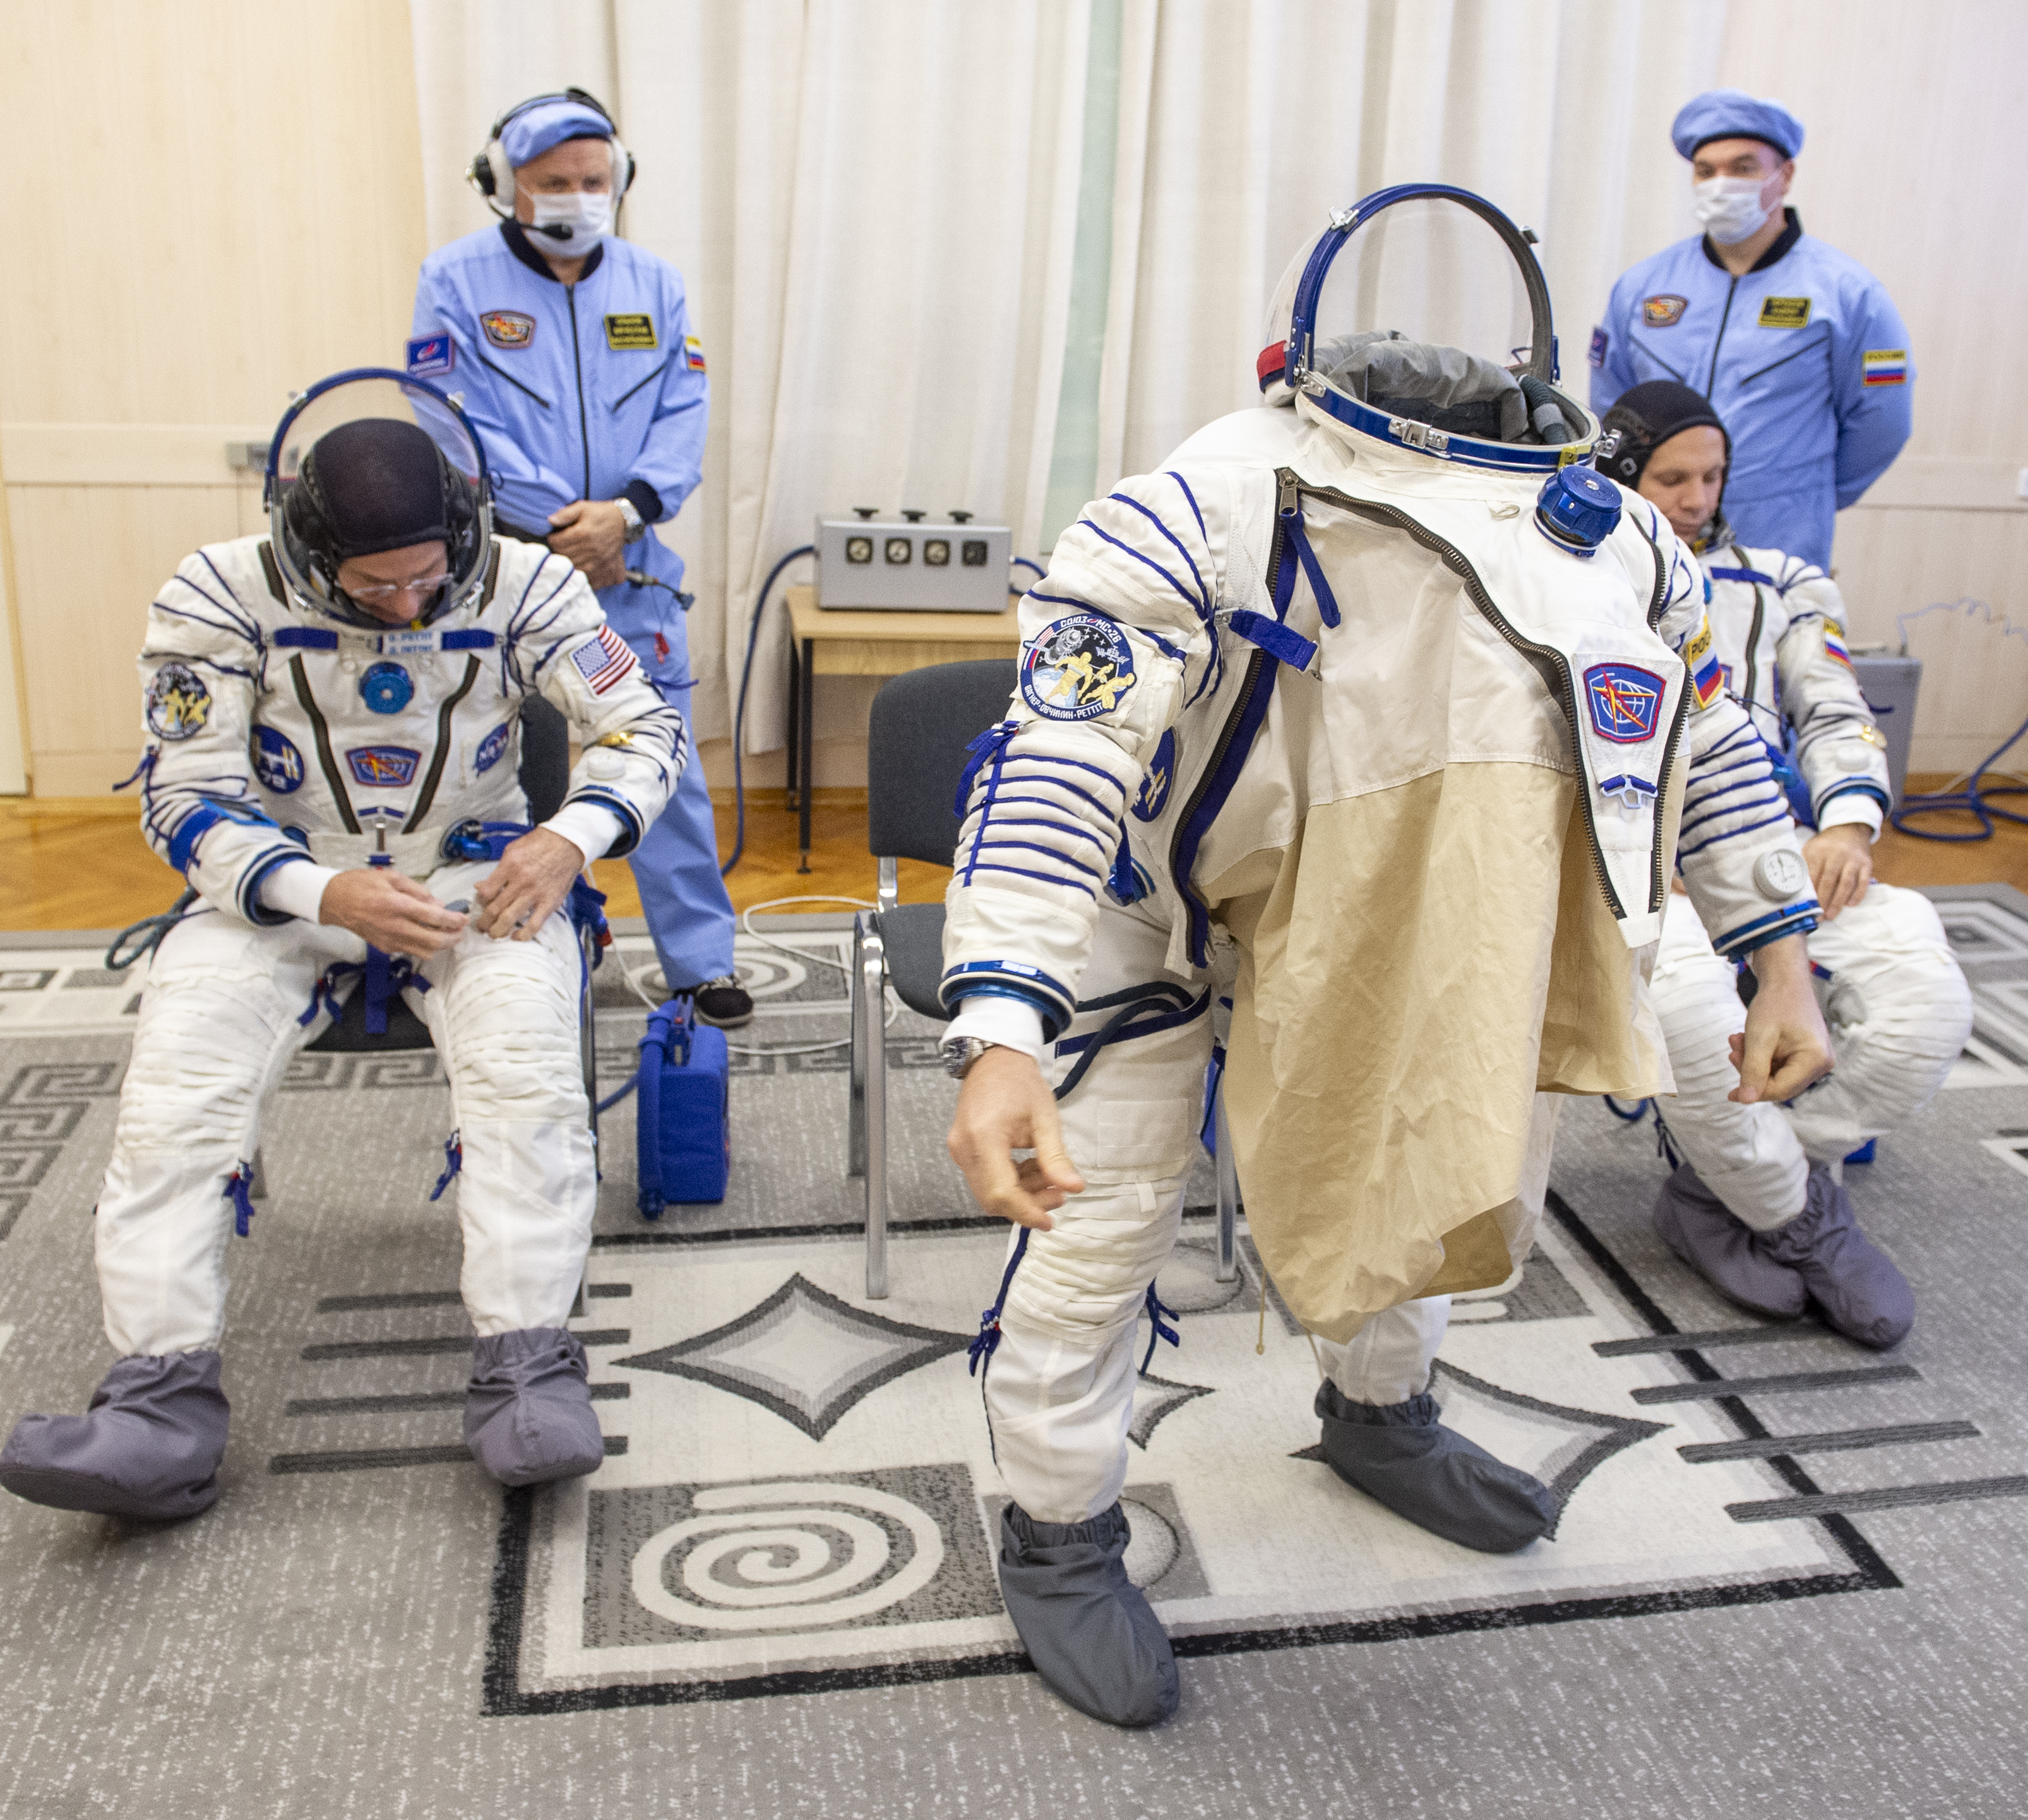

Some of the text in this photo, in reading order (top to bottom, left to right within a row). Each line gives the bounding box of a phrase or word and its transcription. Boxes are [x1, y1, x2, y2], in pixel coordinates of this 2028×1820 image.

[1060, 616, 1088, 627] СОЮЗ
[1024, 684, 1073, 719] ВАГНЕР ОВЧИНИН
[1076, 702, 1103, 718] PETTIT
